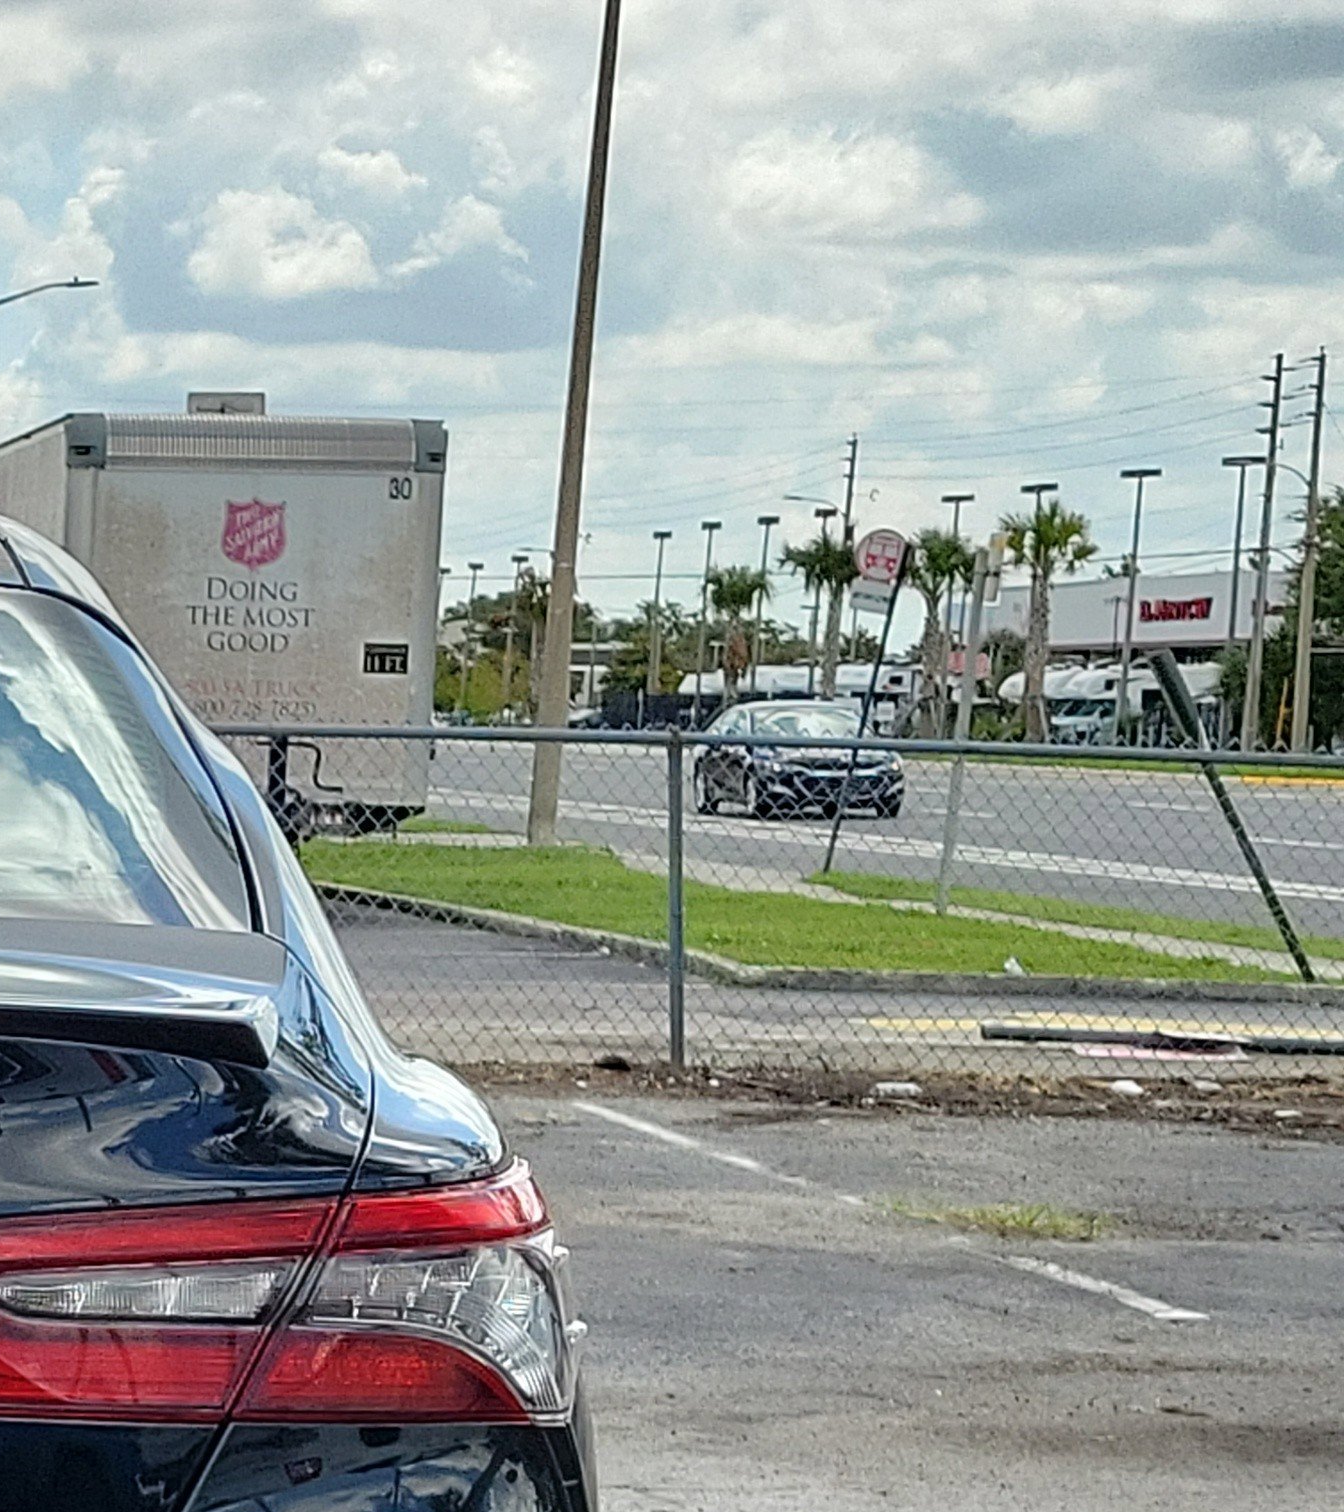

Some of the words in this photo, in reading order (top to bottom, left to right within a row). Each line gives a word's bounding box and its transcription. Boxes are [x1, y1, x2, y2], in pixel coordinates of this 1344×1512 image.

[389, 477, 412, 499] 30
[207, 576, 298, 602] DOING
[185, 604, 235, 626] THE
[243, 605, 315, 628] MOST
[207, 631, 290, 653] GOOD
